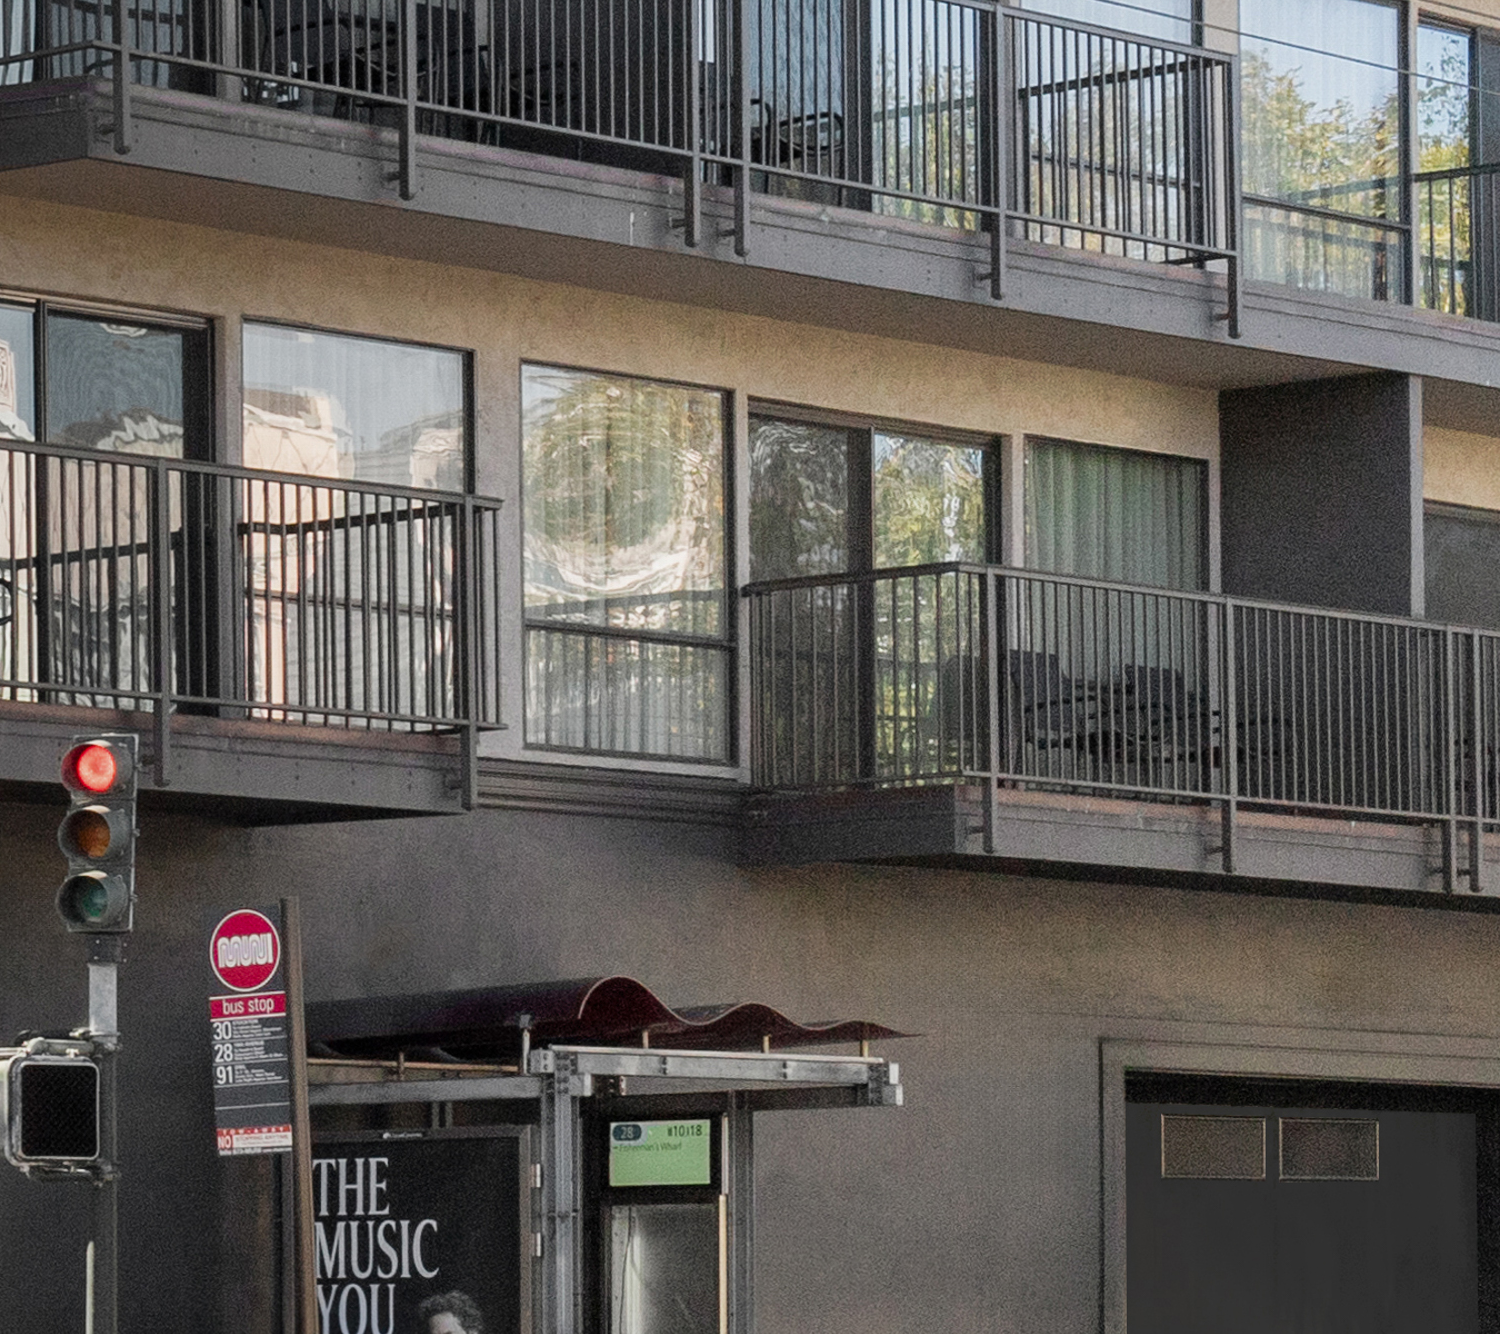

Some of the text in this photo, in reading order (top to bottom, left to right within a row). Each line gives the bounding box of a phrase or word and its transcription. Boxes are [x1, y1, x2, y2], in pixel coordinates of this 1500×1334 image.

[222, 997, 274, 1015] bus stop
[213, 1021, 232, 1041] 30
[214, 1043, 233, 1063] 28
[216, 1065, 233, 1085] 91
[218, 1135, 232, 1148] NO
[620, 1126, 635, 1139] 28
[312, 1157, 390, 1216] THE
[314, 1219, 440, 1279] MUSIC
